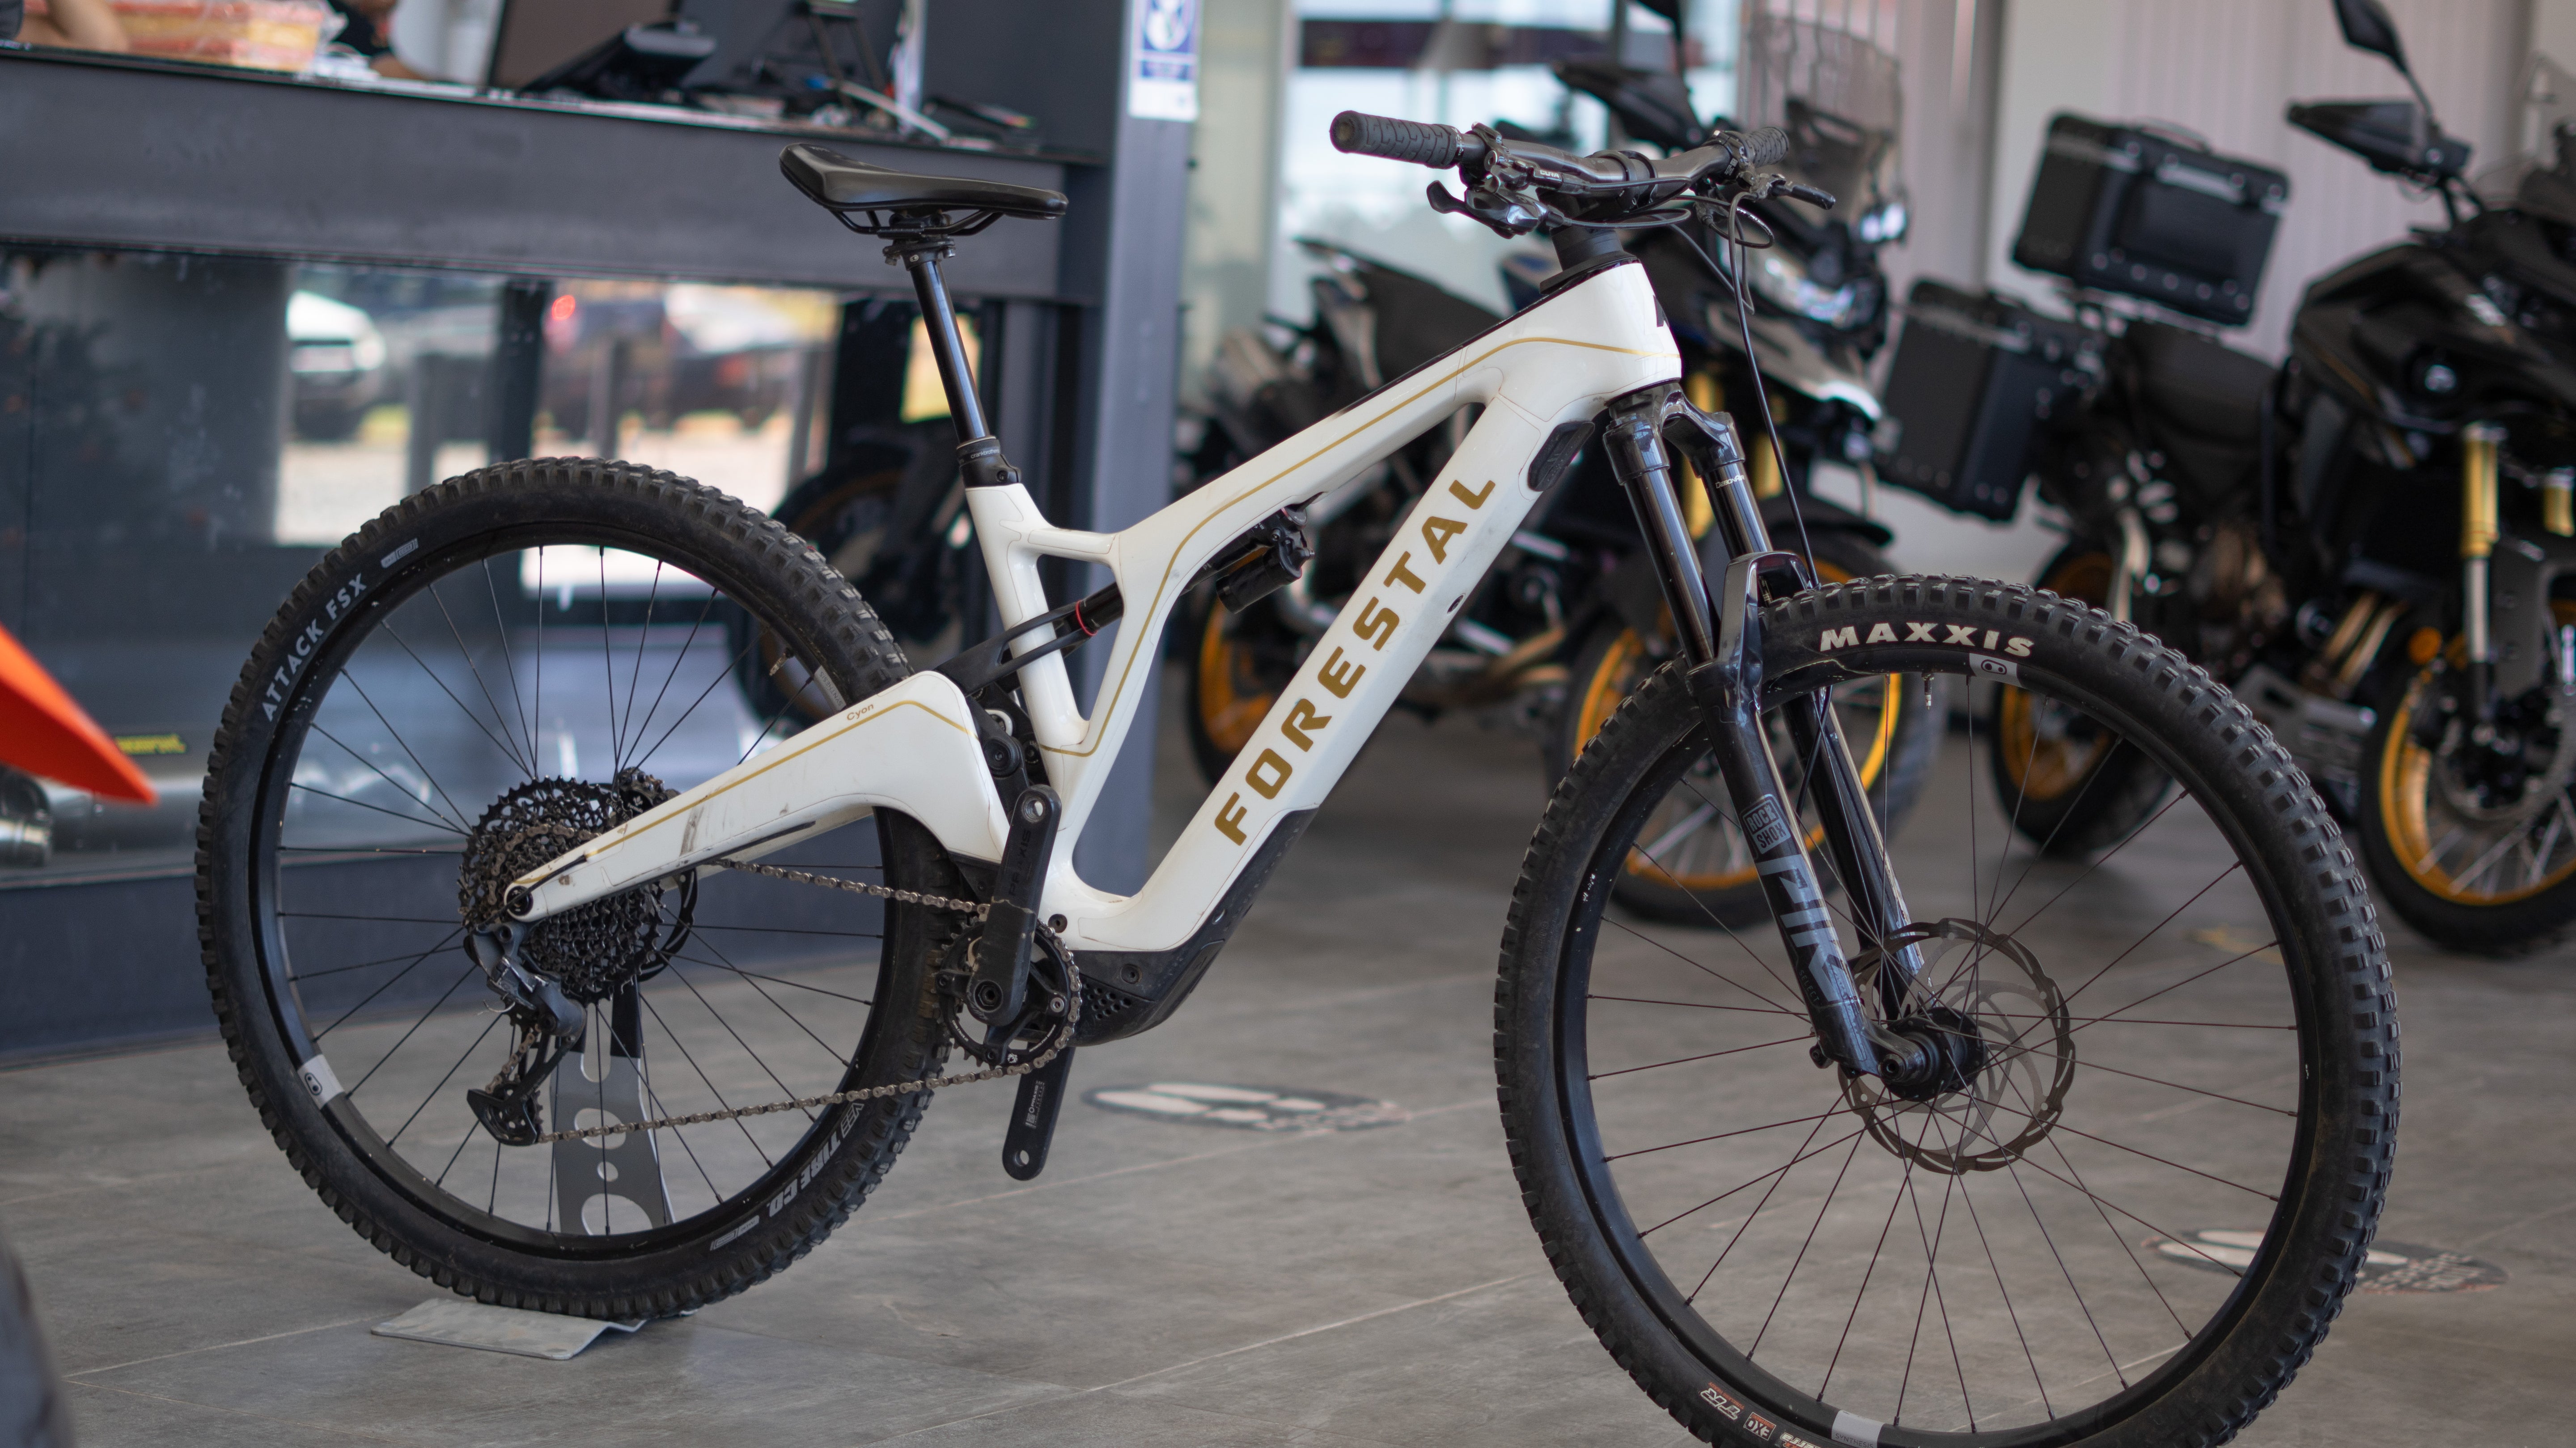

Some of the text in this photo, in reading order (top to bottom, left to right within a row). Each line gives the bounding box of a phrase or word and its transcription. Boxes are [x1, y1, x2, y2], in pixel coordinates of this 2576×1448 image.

[1540, 170, 1560, 178] CURA
[262, 573, 367, 722] ATTACK FSX
[1819, 622, 2035, 658] MAXXIS
[1214, 479, 1496, 846] FORESTAL
[819, 671, 843, 707] SYNTHESIS
[846, 704, 874, 721] Cyon
[606, 798, 622, 814] EAGLE
[1746, 804, 1777, 832] ROCK
[1756, 822, 1787, 849] SHOX
[1799, 969, 1820, 1002] SELECT
[840, 1102, 864, 1139] VEE
[801, 1131, 841, 1190] TIRE
[1700, 1388, 1741, 1420] TR
[1745, 1416, 1772, 1439] EXO
[1781, 1433, 1822, 1448] erra
[1835, 1433, 1873, 1448] SYNTHESIS
